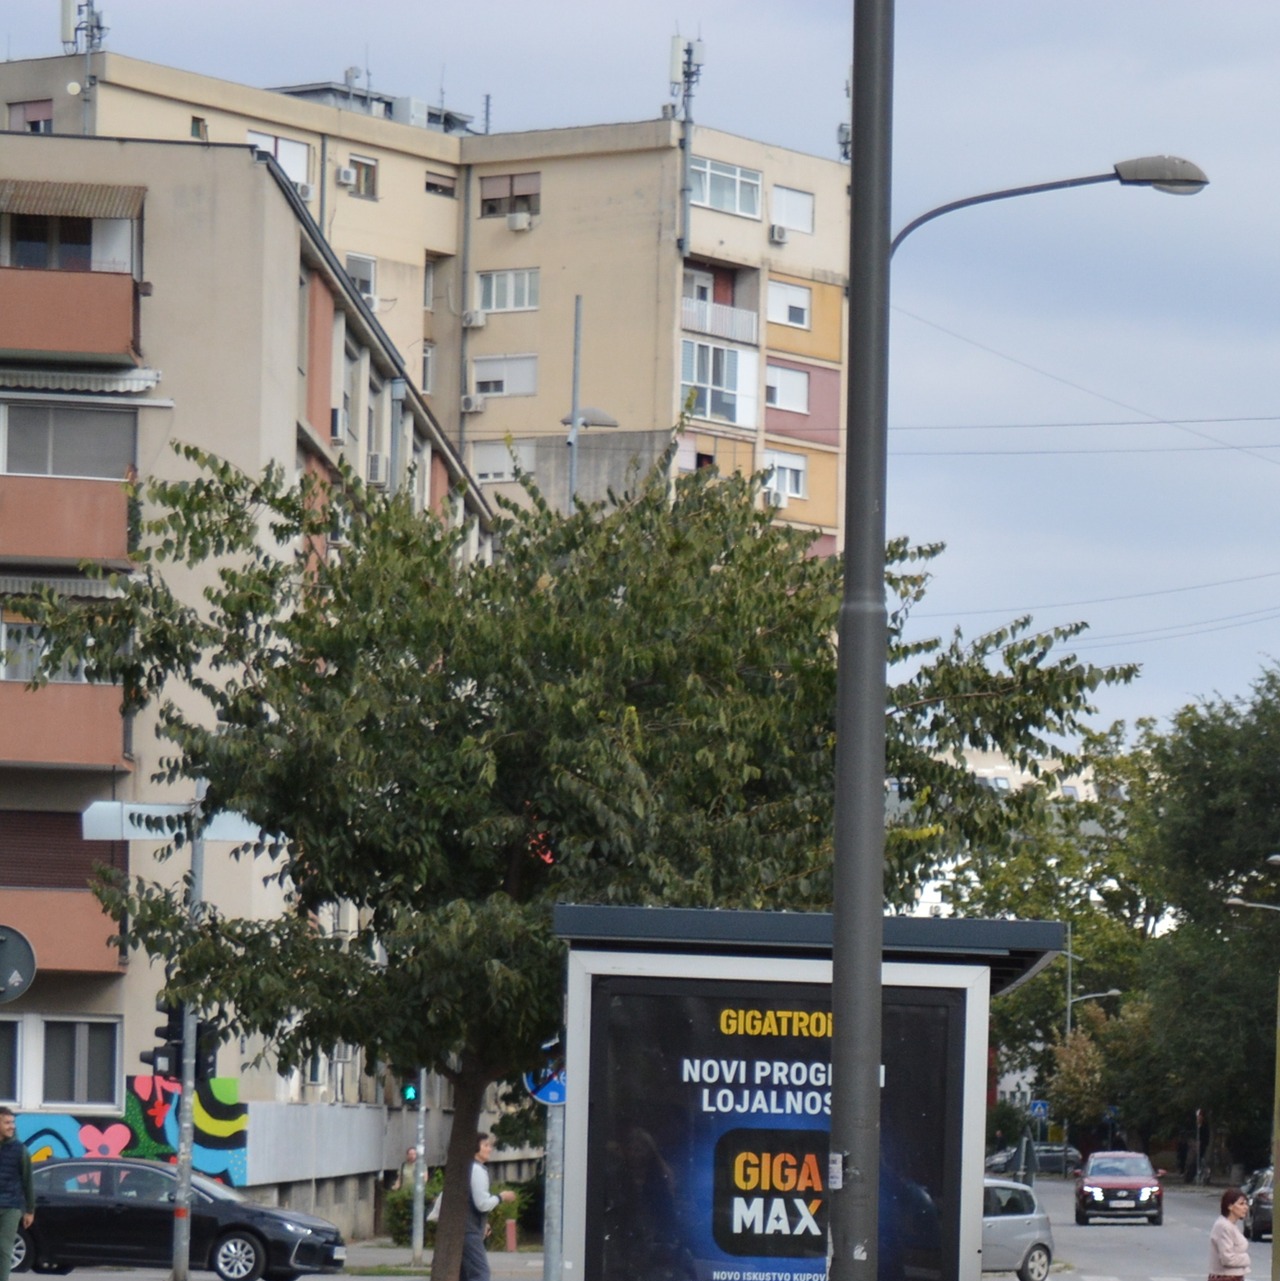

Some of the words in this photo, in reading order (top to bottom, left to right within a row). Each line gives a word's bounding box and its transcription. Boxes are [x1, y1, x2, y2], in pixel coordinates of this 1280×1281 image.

[682, 1059, 746, 1084] NOVI
[735, 1151, 823, 1191] GIGA
[733, 1197, 822, 1235] MAX
[713, 1271, 740, 1281] NOVO
[743, 1272, 790, 1281] ISKUSTVO
